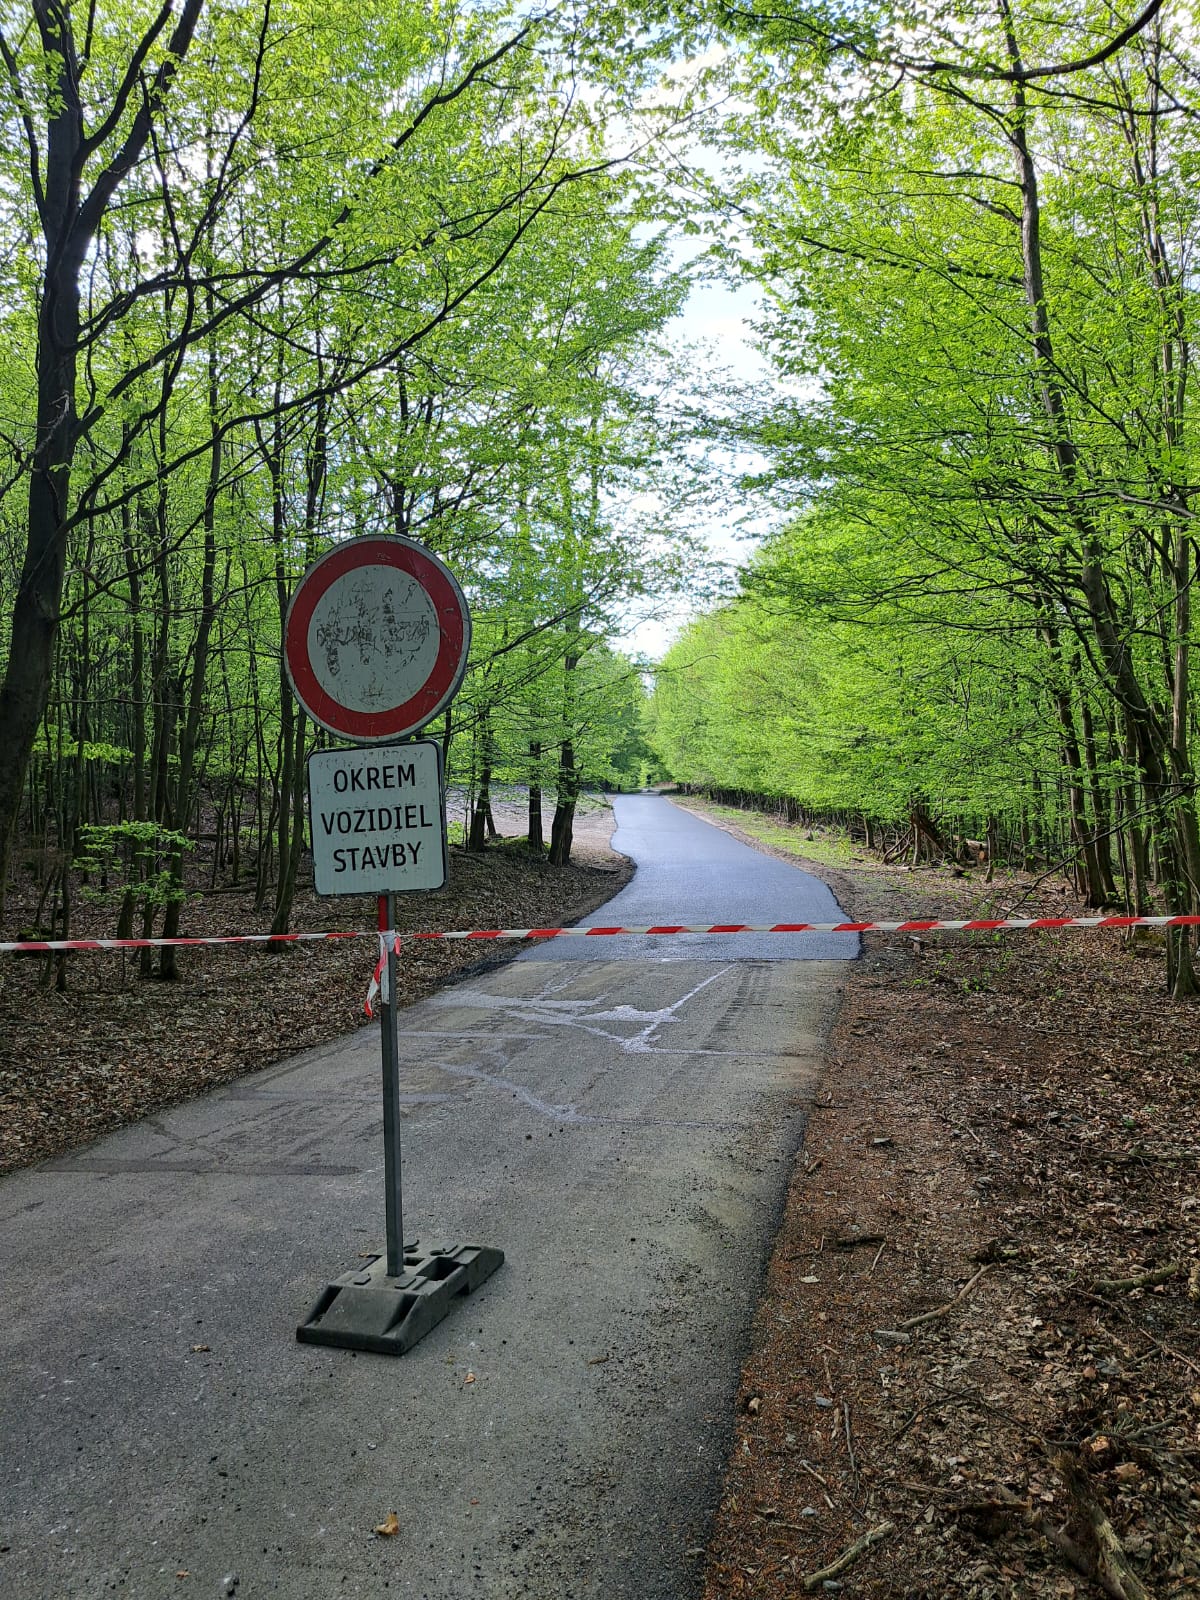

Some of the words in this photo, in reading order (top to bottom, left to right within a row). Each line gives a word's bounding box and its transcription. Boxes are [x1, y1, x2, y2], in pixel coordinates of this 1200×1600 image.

[333, 763, 416, 793] OKREM
[320, 804, 433, 835] VOZIDIEL
[333, 841, 422, 873] STAVBY
